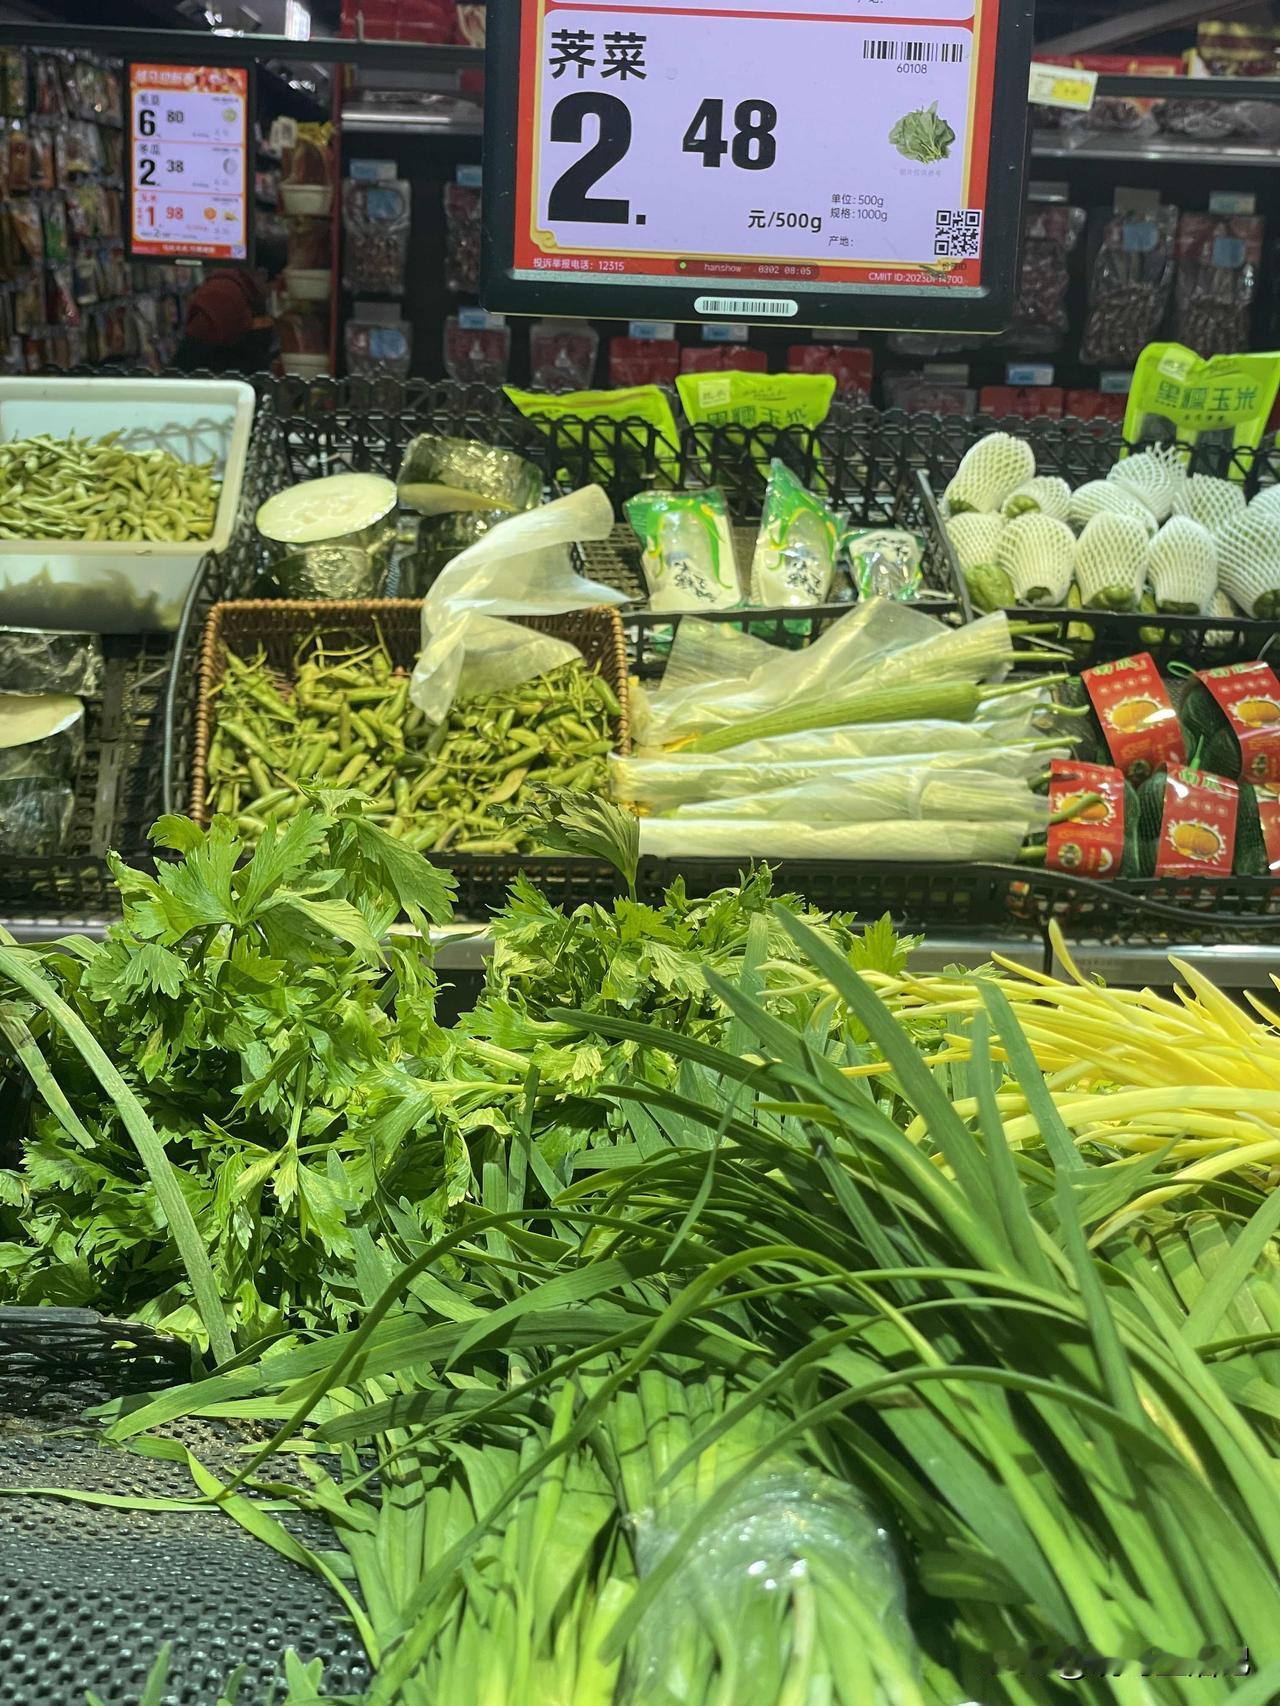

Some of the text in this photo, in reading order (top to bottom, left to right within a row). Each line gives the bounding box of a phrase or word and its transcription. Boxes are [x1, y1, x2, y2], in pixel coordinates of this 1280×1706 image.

[549, 29, 647, 81] 荠菜
[896, 63, 928, 74] 60108
[682, 98, 778, 171] 48
[748, 209, 822, 233] 元/500g
[704, 263, 742, 273] hanshow
[758, 265, 780, 274] 0302
